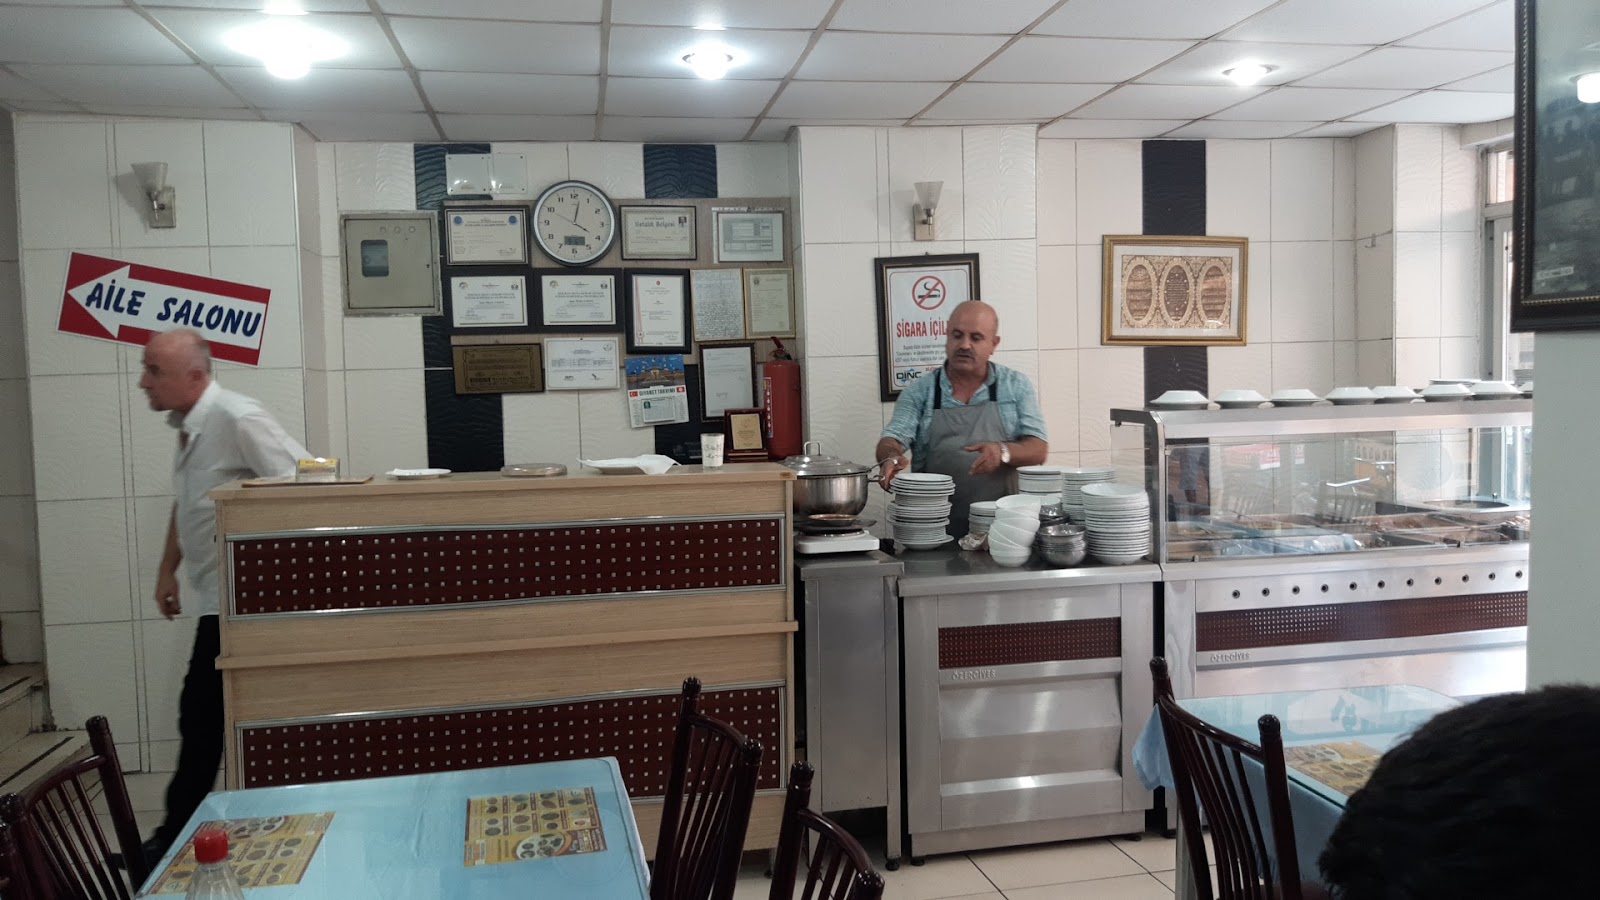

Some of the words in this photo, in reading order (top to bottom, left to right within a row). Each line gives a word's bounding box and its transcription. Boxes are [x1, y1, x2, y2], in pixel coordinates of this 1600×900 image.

[85, 278, 146, 316] AİLE
[156, 297, 263, 337] SALONU
[896, 319, 927, 337] SİGARA
[930, 317, 948, 340] İÇİL
